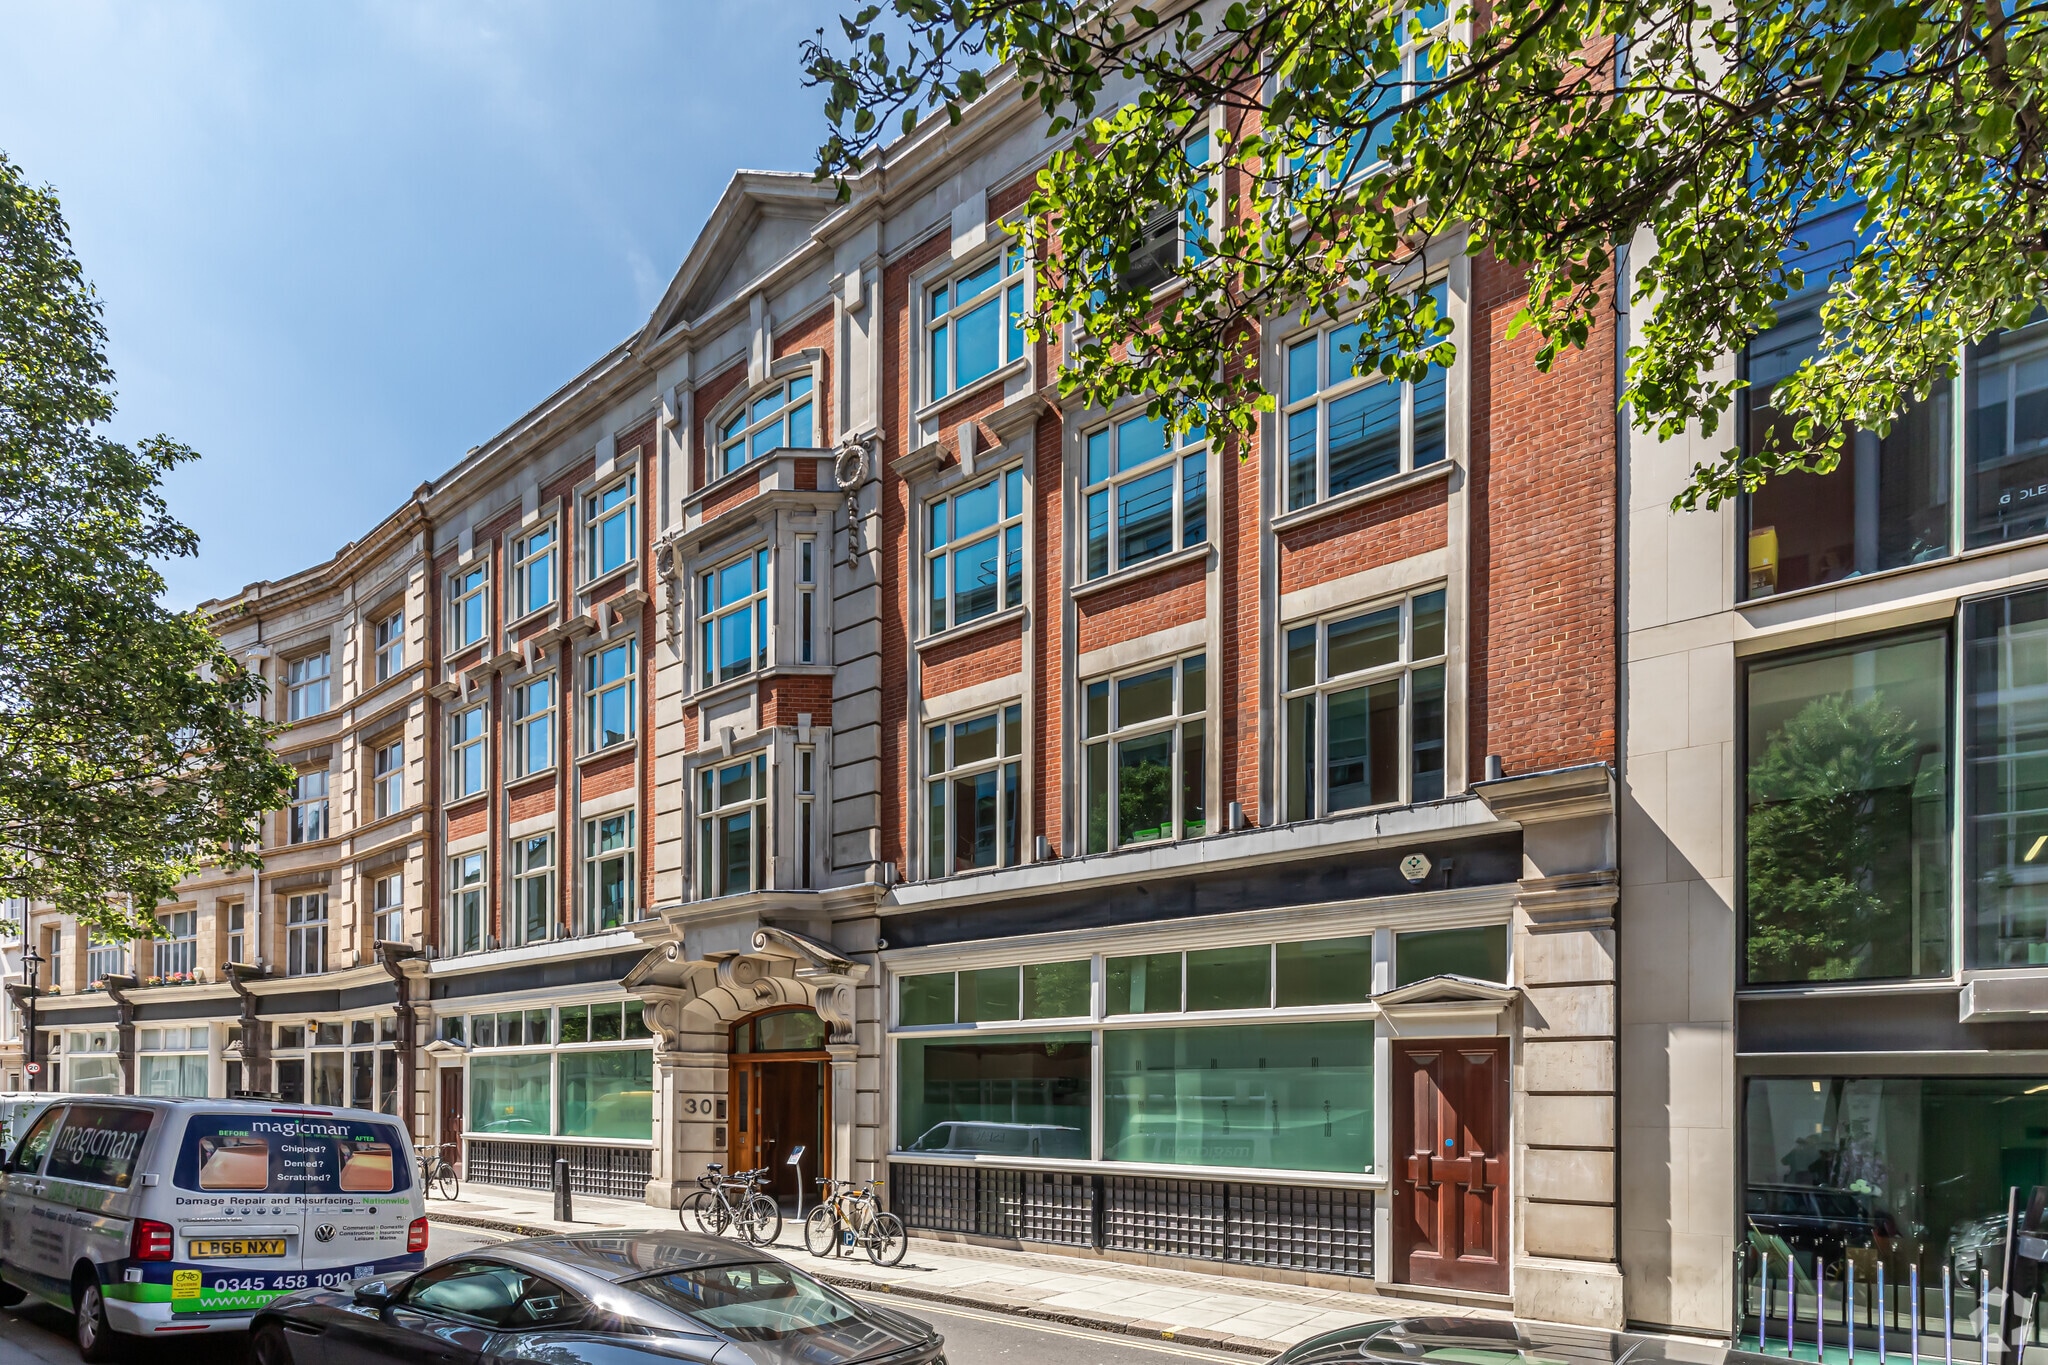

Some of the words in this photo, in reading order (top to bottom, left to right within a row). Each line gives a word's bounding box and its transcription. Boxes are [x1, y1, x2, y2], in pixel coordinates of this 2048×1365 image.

[684, 1098, 712, 1115] 30
[252, 1120, 349, 1137] magicman
[56, 1125, 138, 1165] magicman
[281, 1145, 326, 1153] Chipped?
[284, 1160, 324, 1168] Dented?
[277, 1173, 331, 1181] Scratched?
[176, 1197, 225, 1206] Damage
[230, 1196, 266, 1205] Repair
[270, 1196, 290, 1205] and
[362, 1197, 410, 1205] Nationwide
[846, 1232, 854, 1245] P
[198, 1242, 243, 1255] LB66
[247, 1240, 279, 1254] NXY
[214, 1277, 265, 1293] 0345
[272, 1275, 308, 1290] 458
[315, 1272, 352, 1287] 1010
